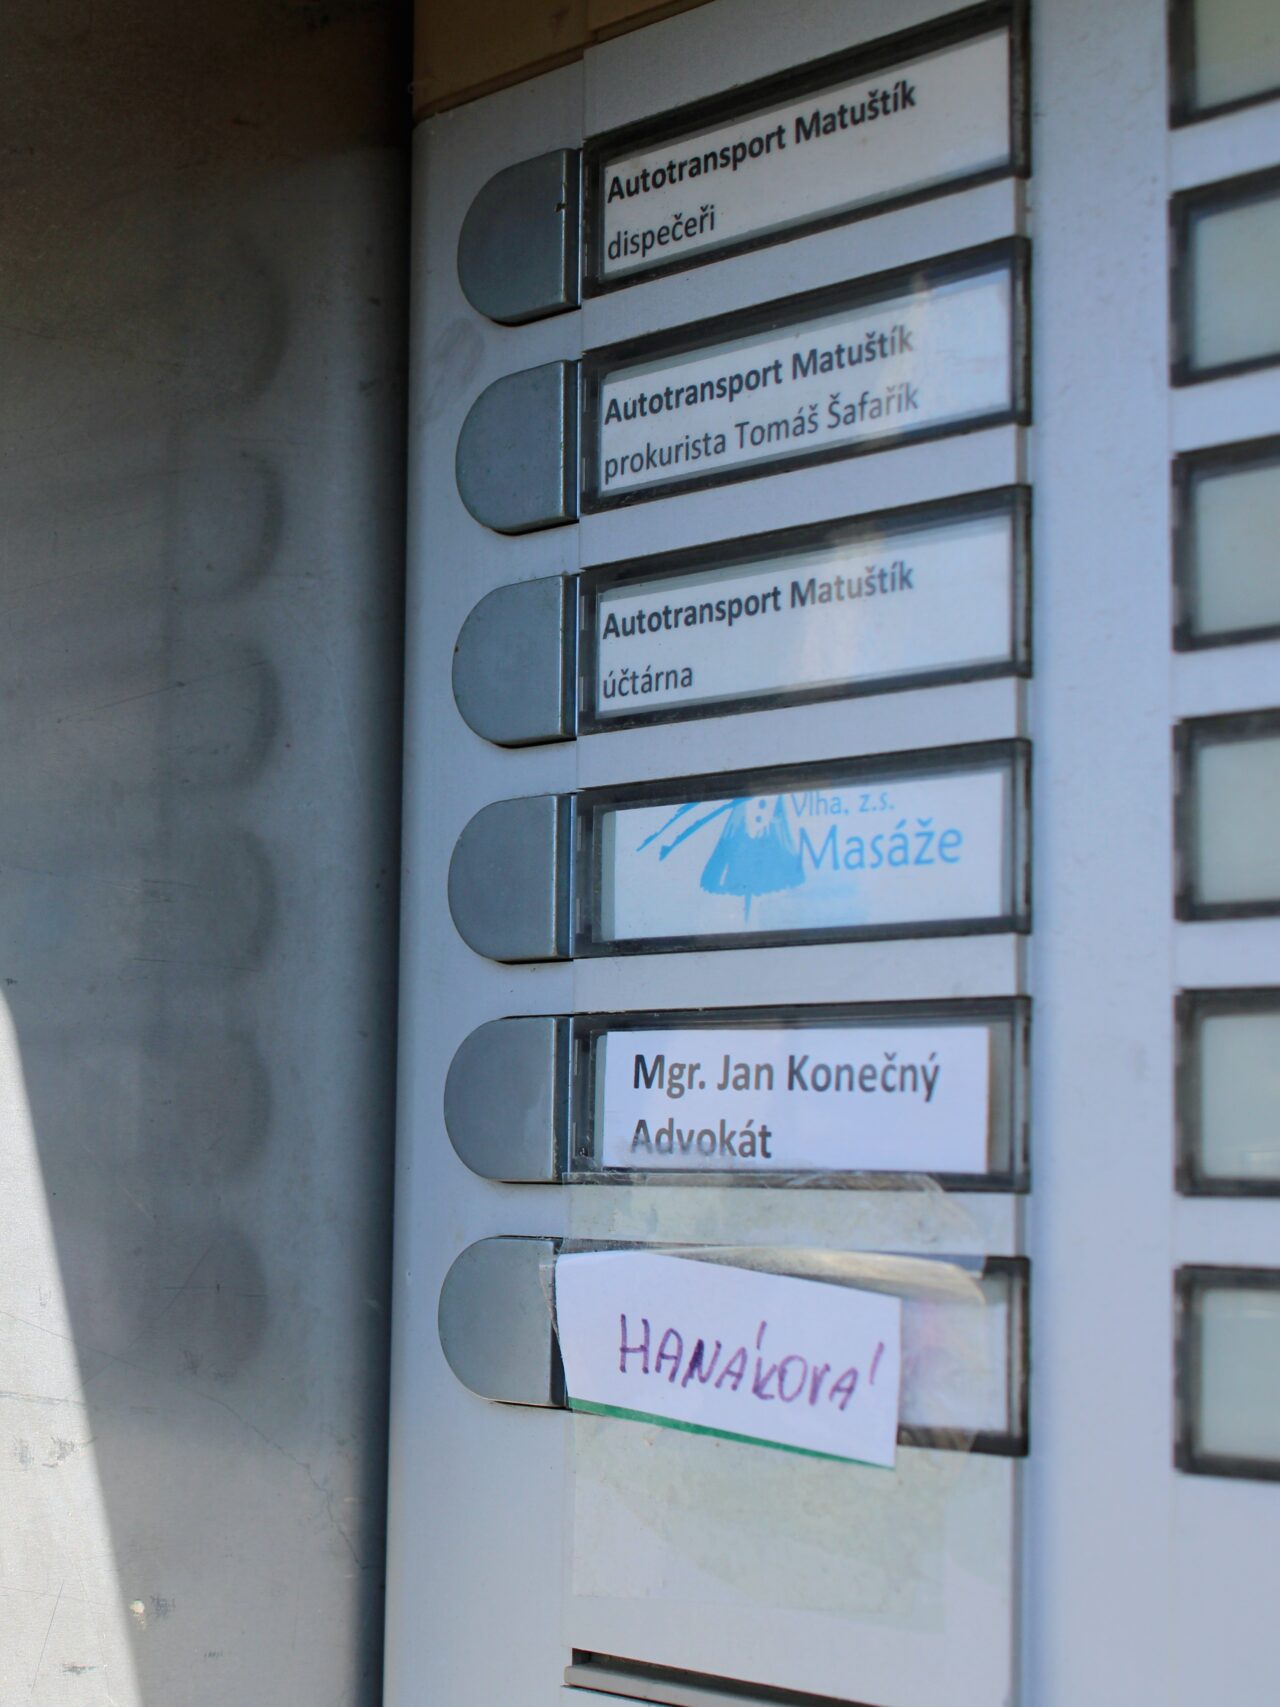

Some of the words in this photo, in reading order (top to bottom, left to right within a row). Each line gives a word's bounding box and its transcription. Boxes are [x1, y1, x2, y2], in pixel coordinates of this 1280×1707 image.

[607, 125, 786, 203] Autotransport
[795, 79, 916, 144] Matuštík
[608, 205, 715, 259] dispečeři
[604, 359, 782, 425] Autotransport
[792, 325, 913, 380] Matuštík
[604, 430, 726, 484] prokurista
[735, 405, 819, 450] Tomáš
[827, 382, 919, 429] Šafařík
[603, 586, 781, 640] Autotransport
[790, 560, 914, 608] Matuštík
[603, 665, 694, 699] účtárna
[798, 818, 964, 872] Masáže
[633, 1053, 706, 1099] Mgr.
[717, 1054, 774, 1092] Jan
[787, 1052, 940, 1102] Konečný
[631, 1117, 773, 1159] Advokát
